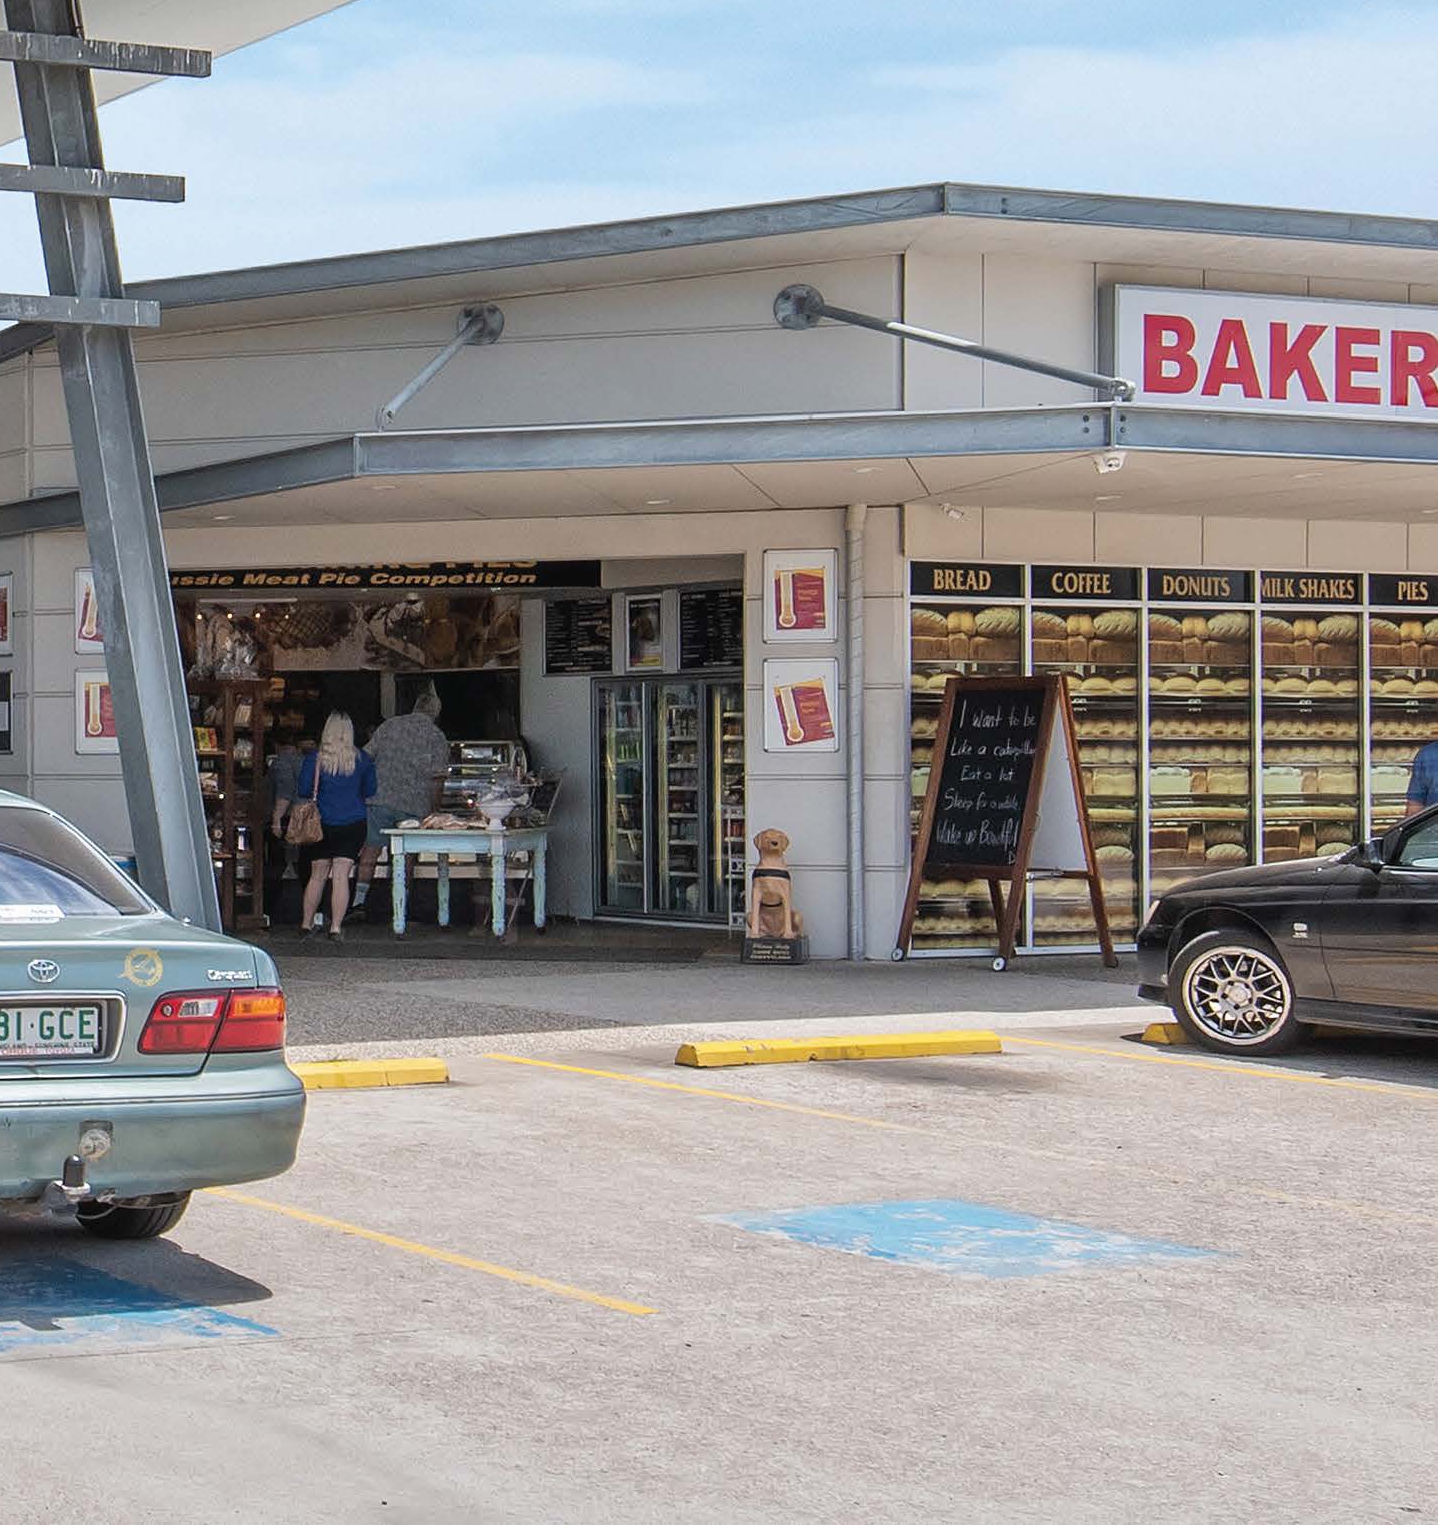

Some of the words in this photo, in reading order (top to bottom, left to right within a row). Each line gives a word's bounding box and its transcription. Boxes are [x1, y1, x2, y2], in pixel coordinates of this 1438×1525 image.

[243, 573, 311, 585] Meat
[318, 572, 361, 585] Pie
[370, 572, 537, 586] Competition
[933, 569, 991, 591] BREAD
[1052, 572, 1112, 594] COFFEE
[1162, 575, 1231, 597] DONUTS
[1260, 578, 1295, 599] MILK
[1299, 579, 1355, 600] SHAKES
[1397, 581, 1429, 601] PIES
[978, 745, 987, 755] a
